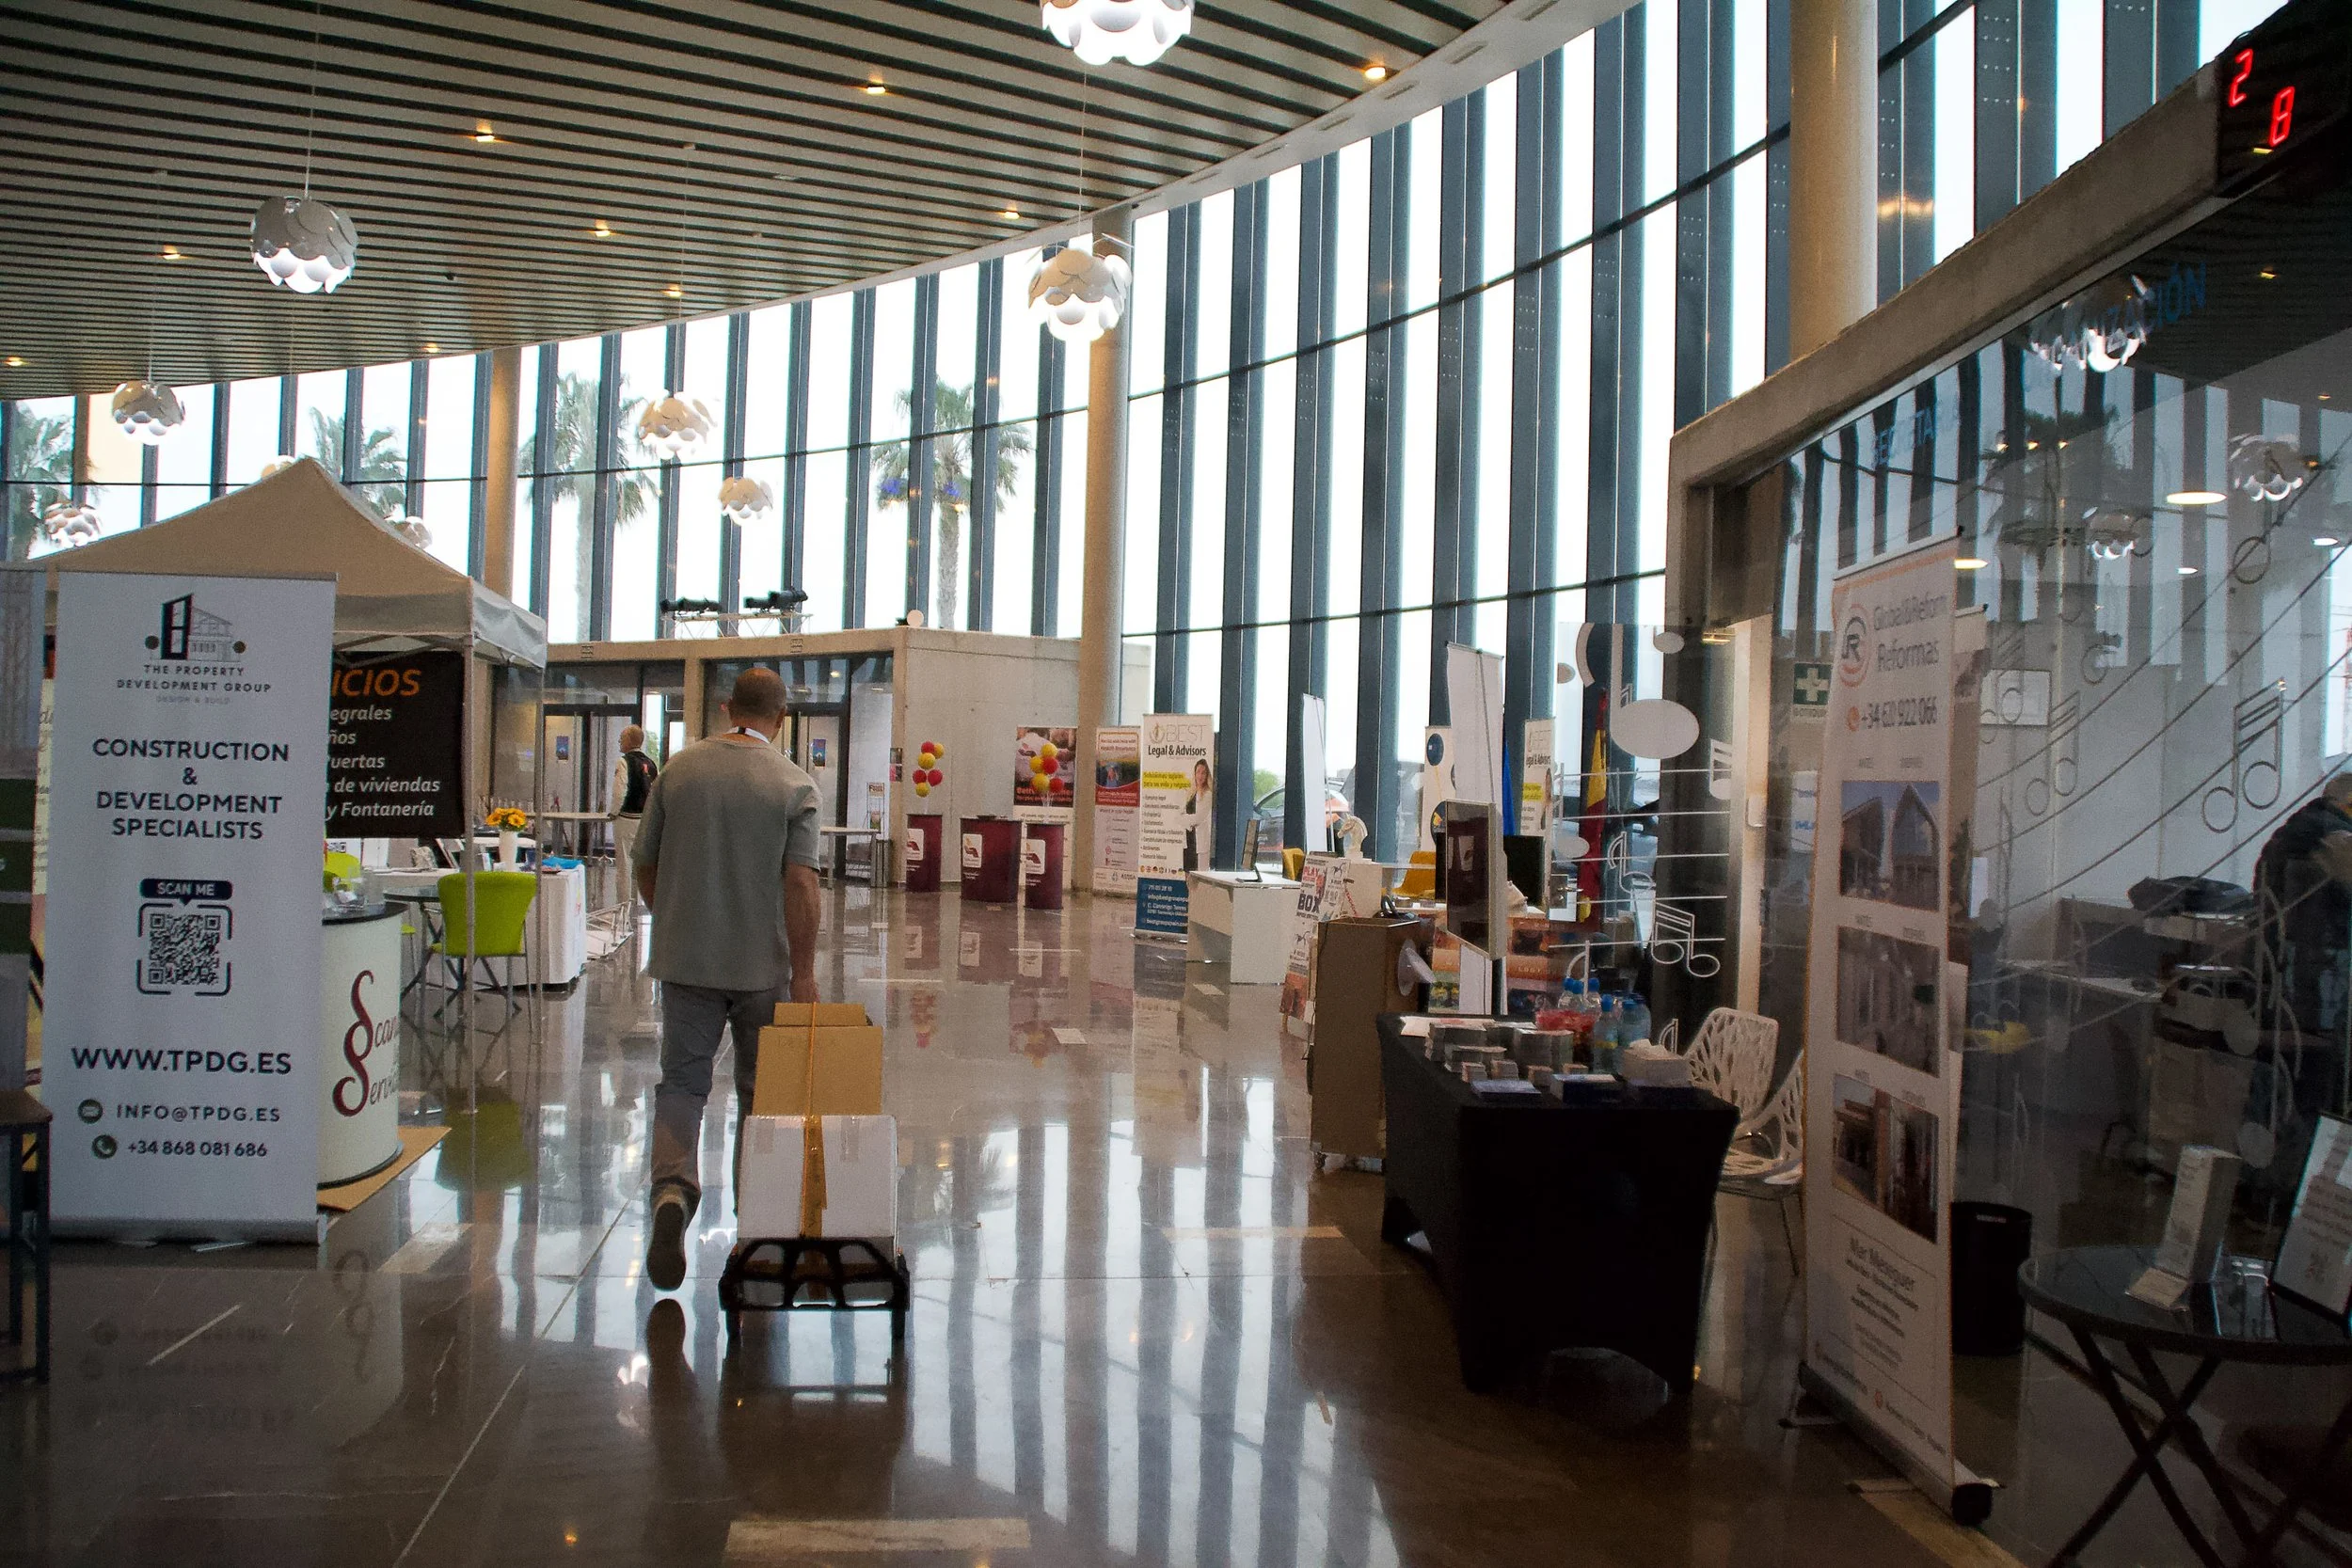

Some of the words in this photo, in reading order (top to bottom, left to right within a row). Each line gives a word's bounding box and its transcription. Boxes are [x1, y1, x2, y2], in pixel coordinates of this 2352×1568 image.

[2268, 86, 2296, 148] 8
[143, 664, 168, 674] THE
[175, 666, 245, 676] PROPERTY
[117, 679, 217, 691] DEVELOPMENT
[224, 682, 272, 693] GROUP
[1166, 724, 1206, 743] BEST
[92, 738, 289, 762] CONSTRUCTION
[1148, 744, 1168, 758] Legal
[1168, 745, 1175, 755] &
[1175, 744, 1207, 756] Advisors
[326, 753, 386, 769] uertas
[182, 767, 198, 785] &
[334, 776, 356, 793] de
[359, 775, 441, 793] viviendas
[96, 791, 282, 814] DEVELOPMENT
[341, 800, 436, 817] Fontanería
[112, 817, 263, 840] SPECIALISTS
[1303, 866, 1320, 877] PLAY
[156, 881, 191, 895] SCAN
[196, 883, 215, 895] ME
[1297, 893, 1320, 913] BOX
[71, 1047, 292, 1075] WWW.TPDG.ES
[116, 1103, 280, 1123] INFO@TPDG.ES
[128, 1139, 158, 1155] +34
[162, 1140, 195, 1156] 868
[199, 1141, 230, 1157] 081
[234, 1142, 268, 1158] 686
